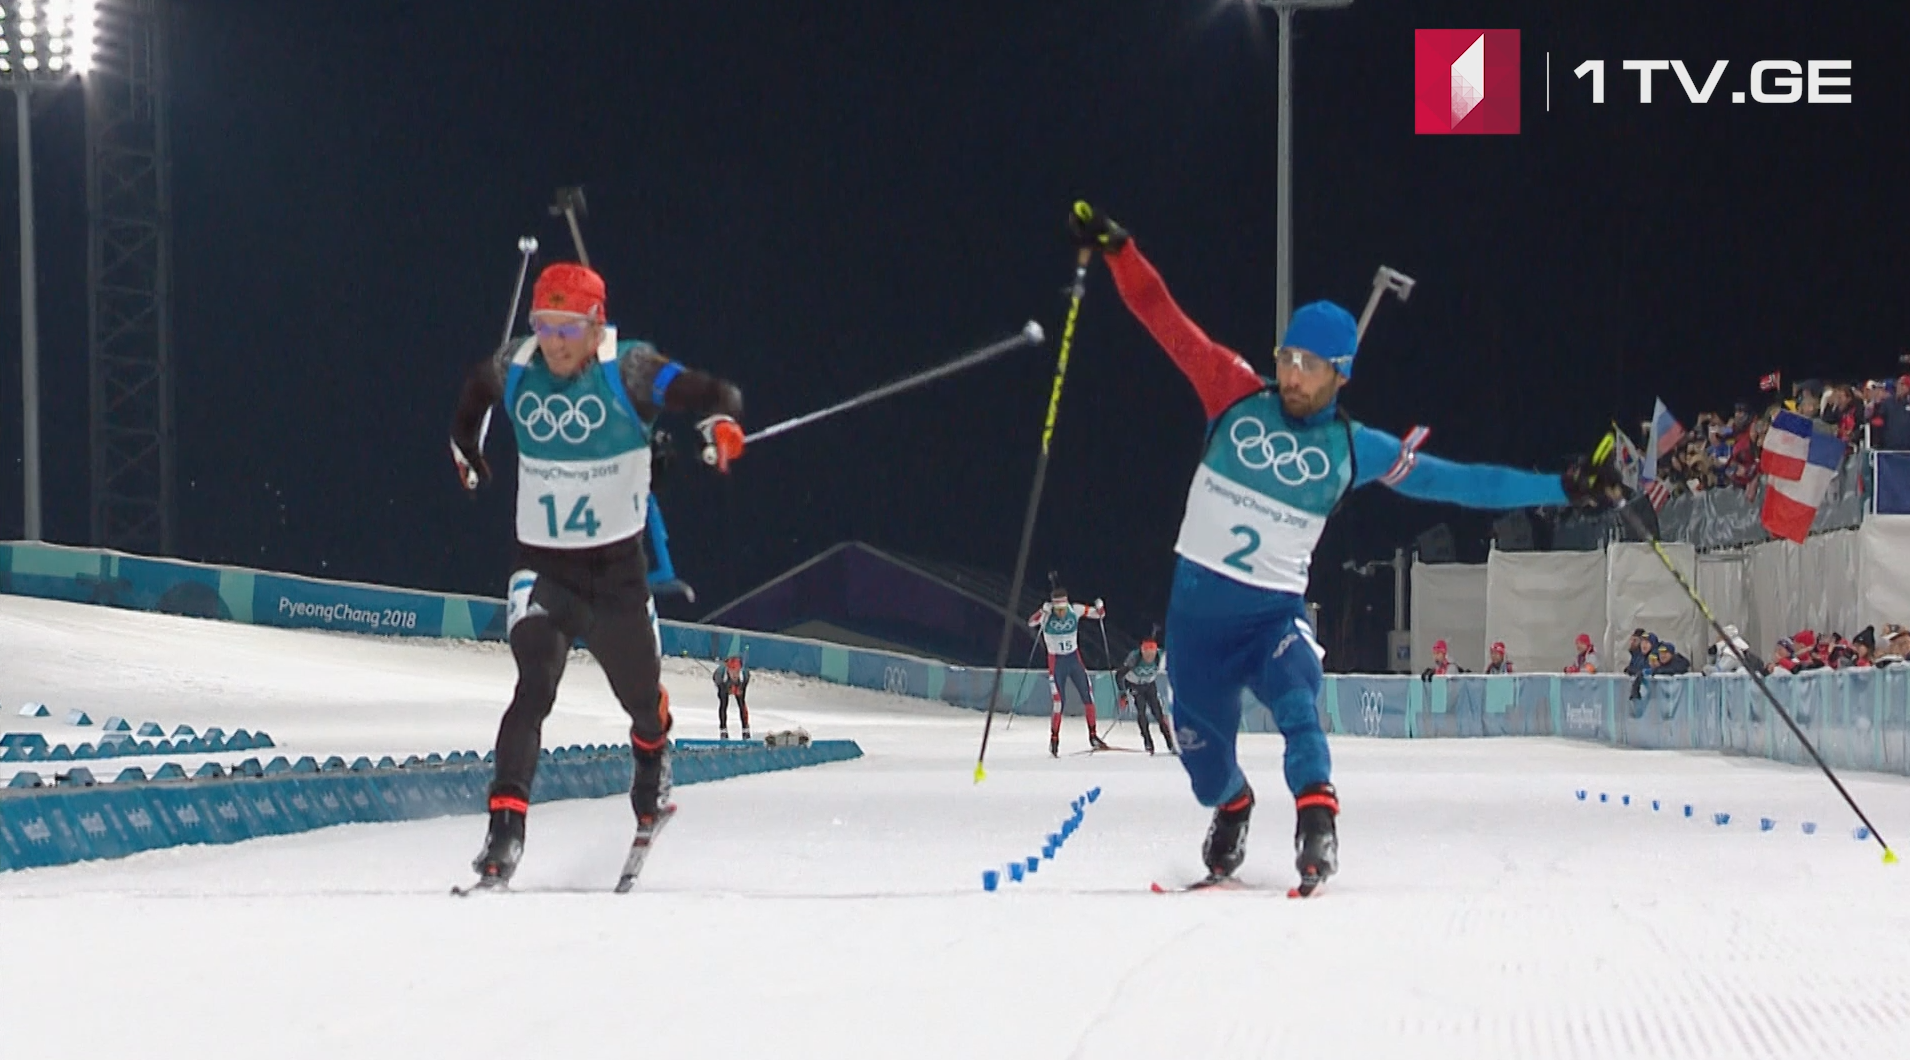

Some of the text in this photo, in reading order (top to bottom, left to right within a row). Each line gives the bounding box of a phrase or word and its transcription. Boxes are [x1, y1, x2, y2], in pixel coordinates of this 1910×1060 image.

[538, 494, 601, 538] 14
[1222, 524, 1262, 575] 2
[278, 596, 417, 629] PyeongChang 2018
[1058, 640, 1073, 651] 15
